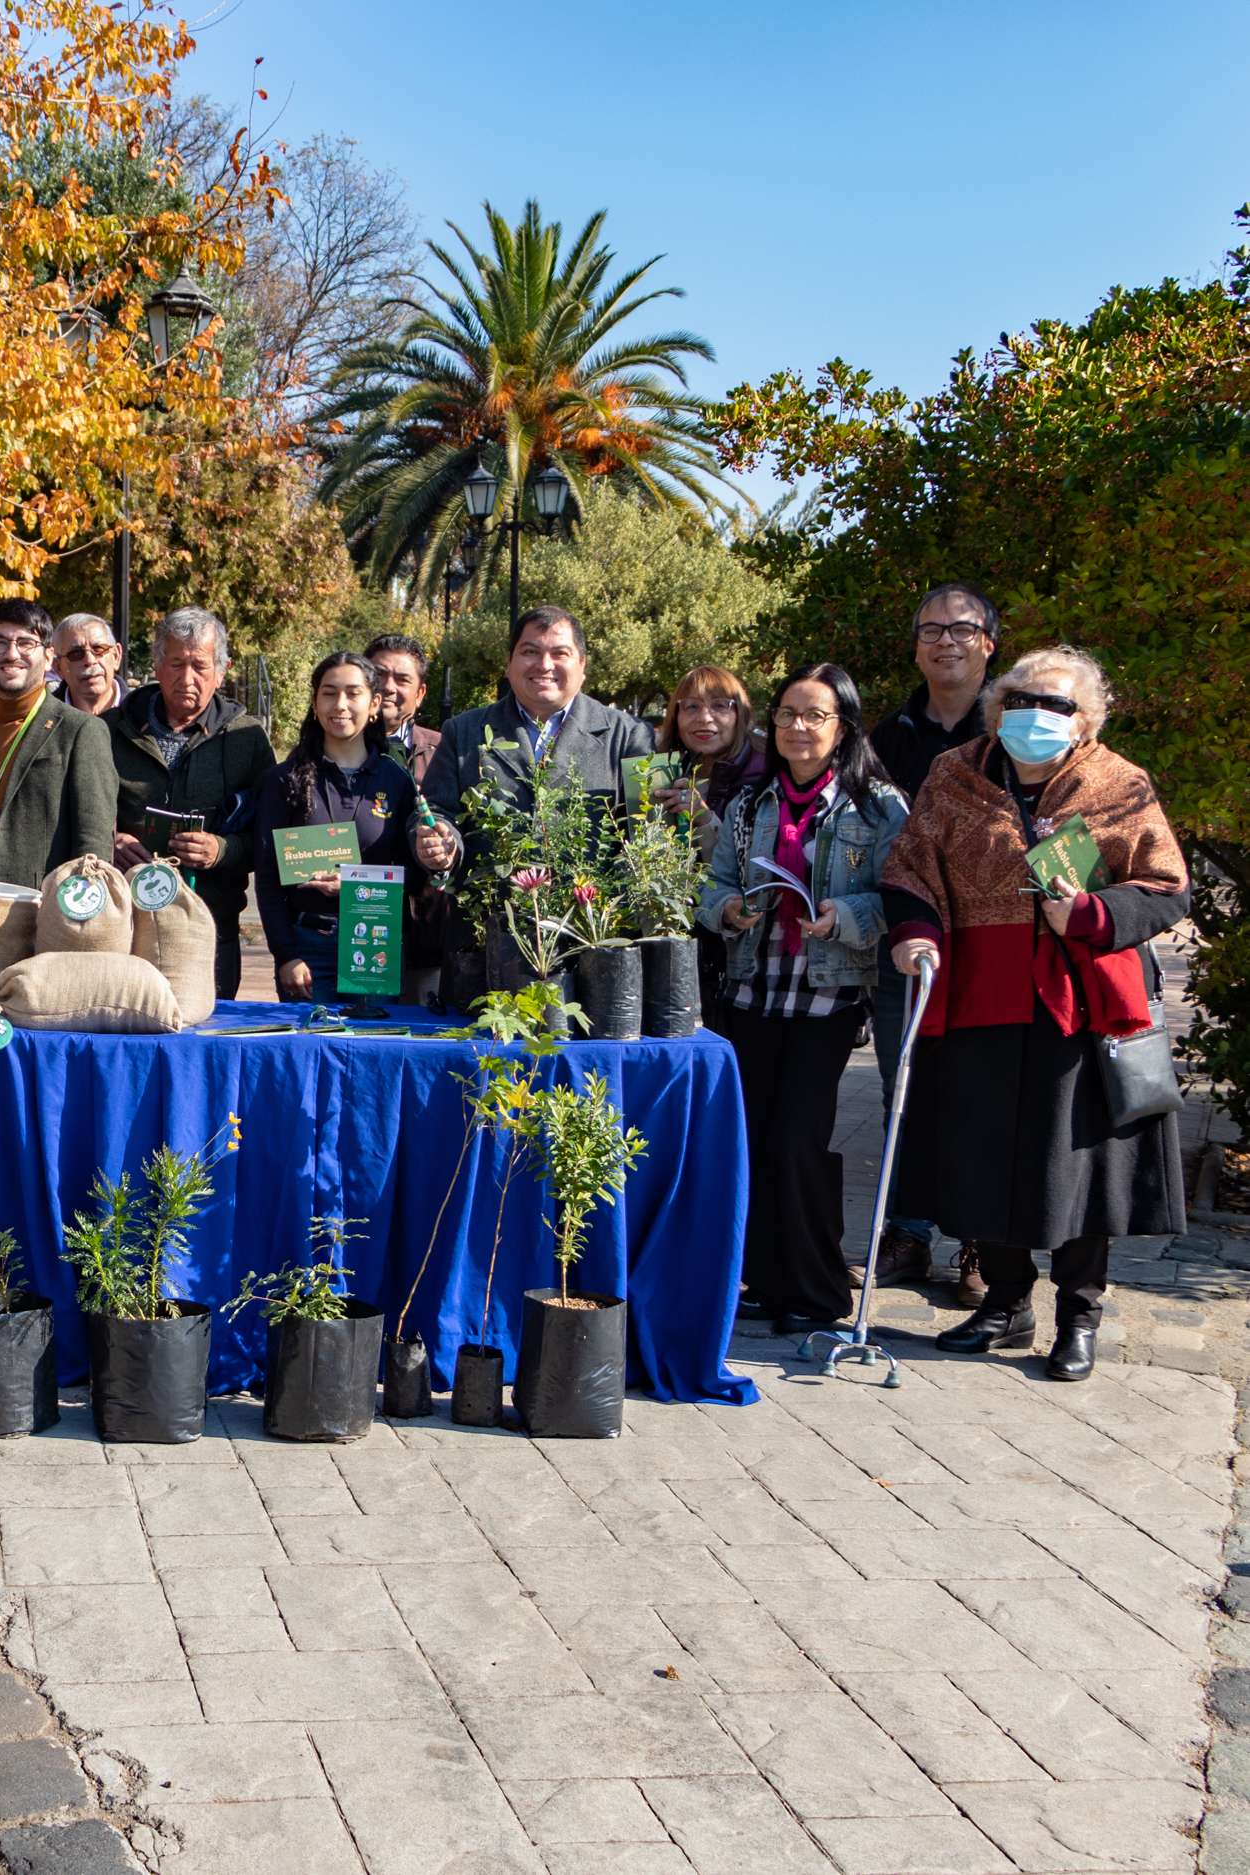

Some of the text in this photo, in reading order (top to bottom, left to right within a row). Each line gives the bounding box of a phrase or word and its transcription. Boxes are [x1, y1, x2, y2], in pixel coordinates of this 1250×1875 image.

[284, 848, 352, 860] Ñuble Circular
[1052, 838, 1071, 868] Ñuble
